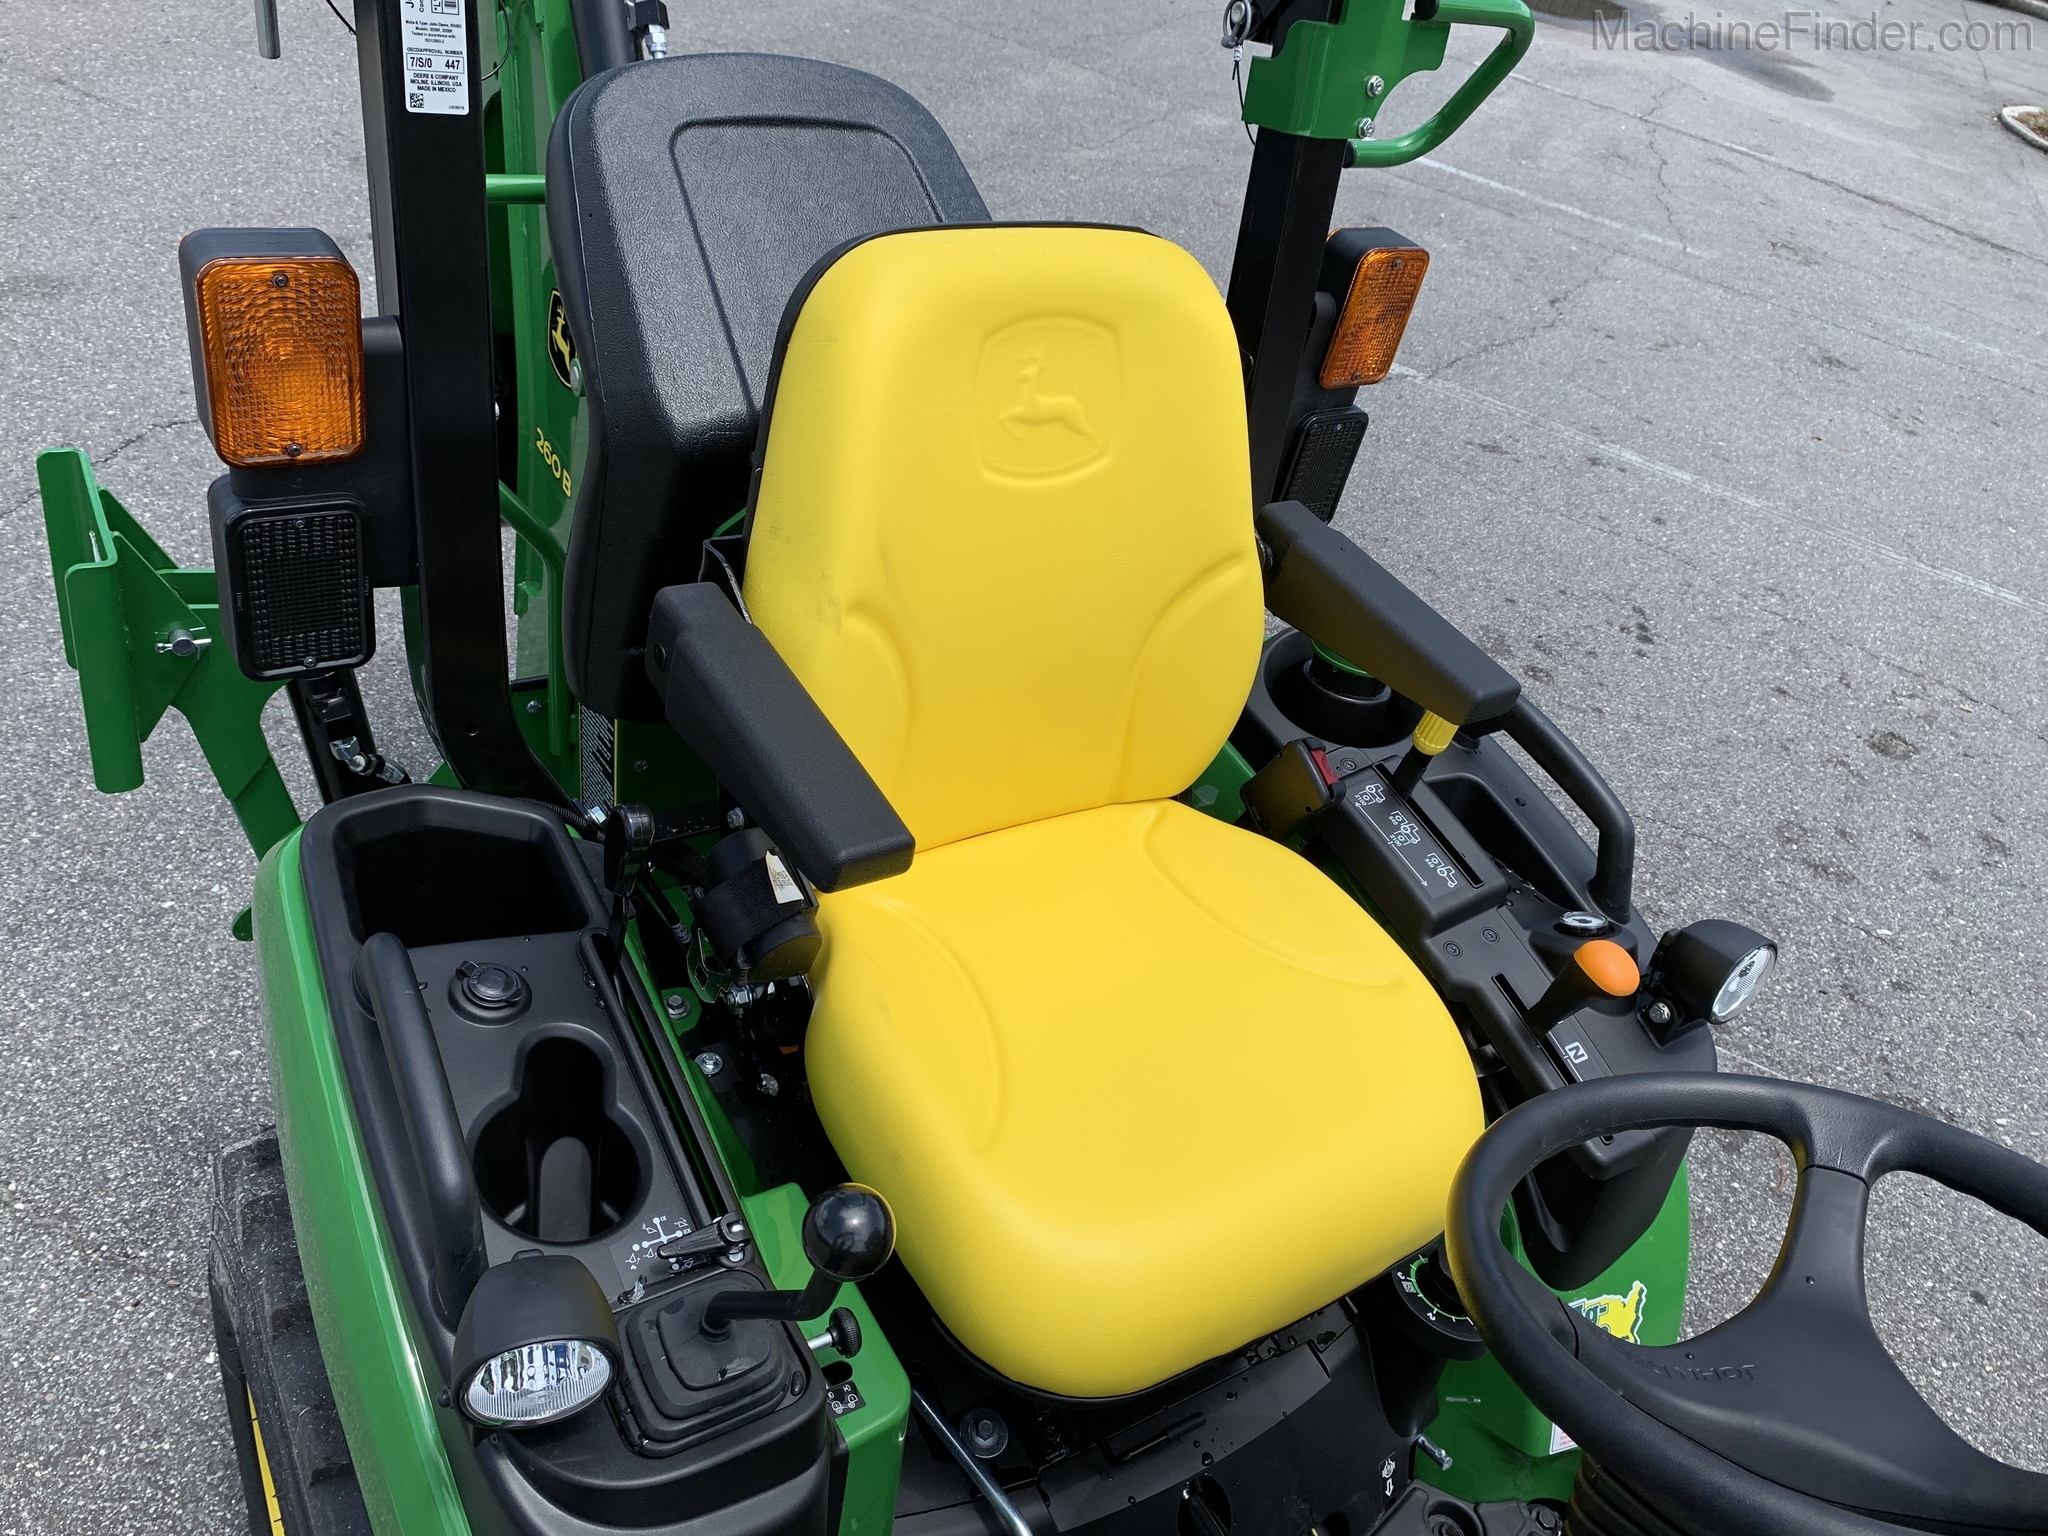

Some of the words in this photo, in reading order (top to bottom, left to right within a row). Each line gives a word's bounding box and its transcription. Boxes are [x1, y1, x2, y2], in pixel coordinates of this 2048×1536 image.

[410, 56, 433, 69] 7/S/0
[444, 59, 461, 70] 447
[535, 426, 561, 479] 260
[562, 468, 572, 498] B
[1397, 1271, 1405, 1280] 3
[1426, 1312, 1436, 1321] 2
